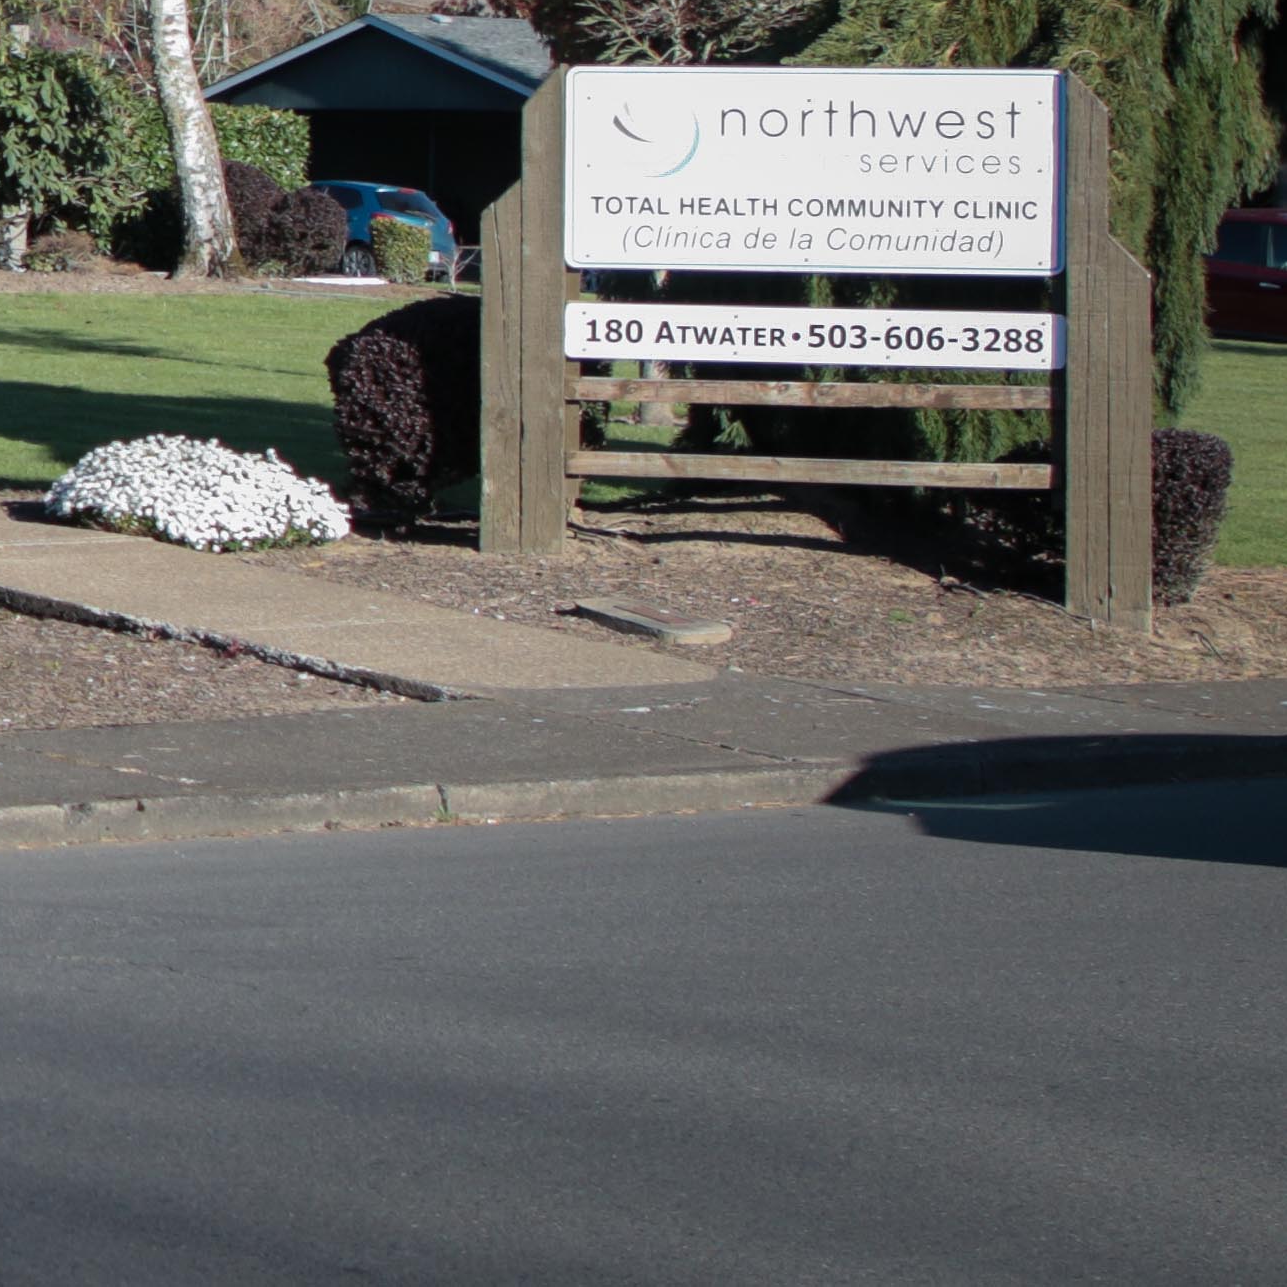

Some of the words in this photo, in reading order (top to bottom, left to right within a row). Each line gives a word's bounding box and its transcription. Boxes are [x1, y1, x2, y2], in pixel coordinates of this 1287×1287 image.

[721, 99, 1021, 139] northwest
[860, 150, 1021, 174] services
[590, 196, 670, 216] TOTAL
[680, 197, 778, 217] HEALTH
[788, 198, 944, 219] COMMUNITY
[954, 200, 1038, 220] CLINIC
[743, 226, 778, 251] de
[789, 227, 813, 252] la
[827, 226, 1004, 259] Comunidad)
[586, 319, 643, 345] 180
